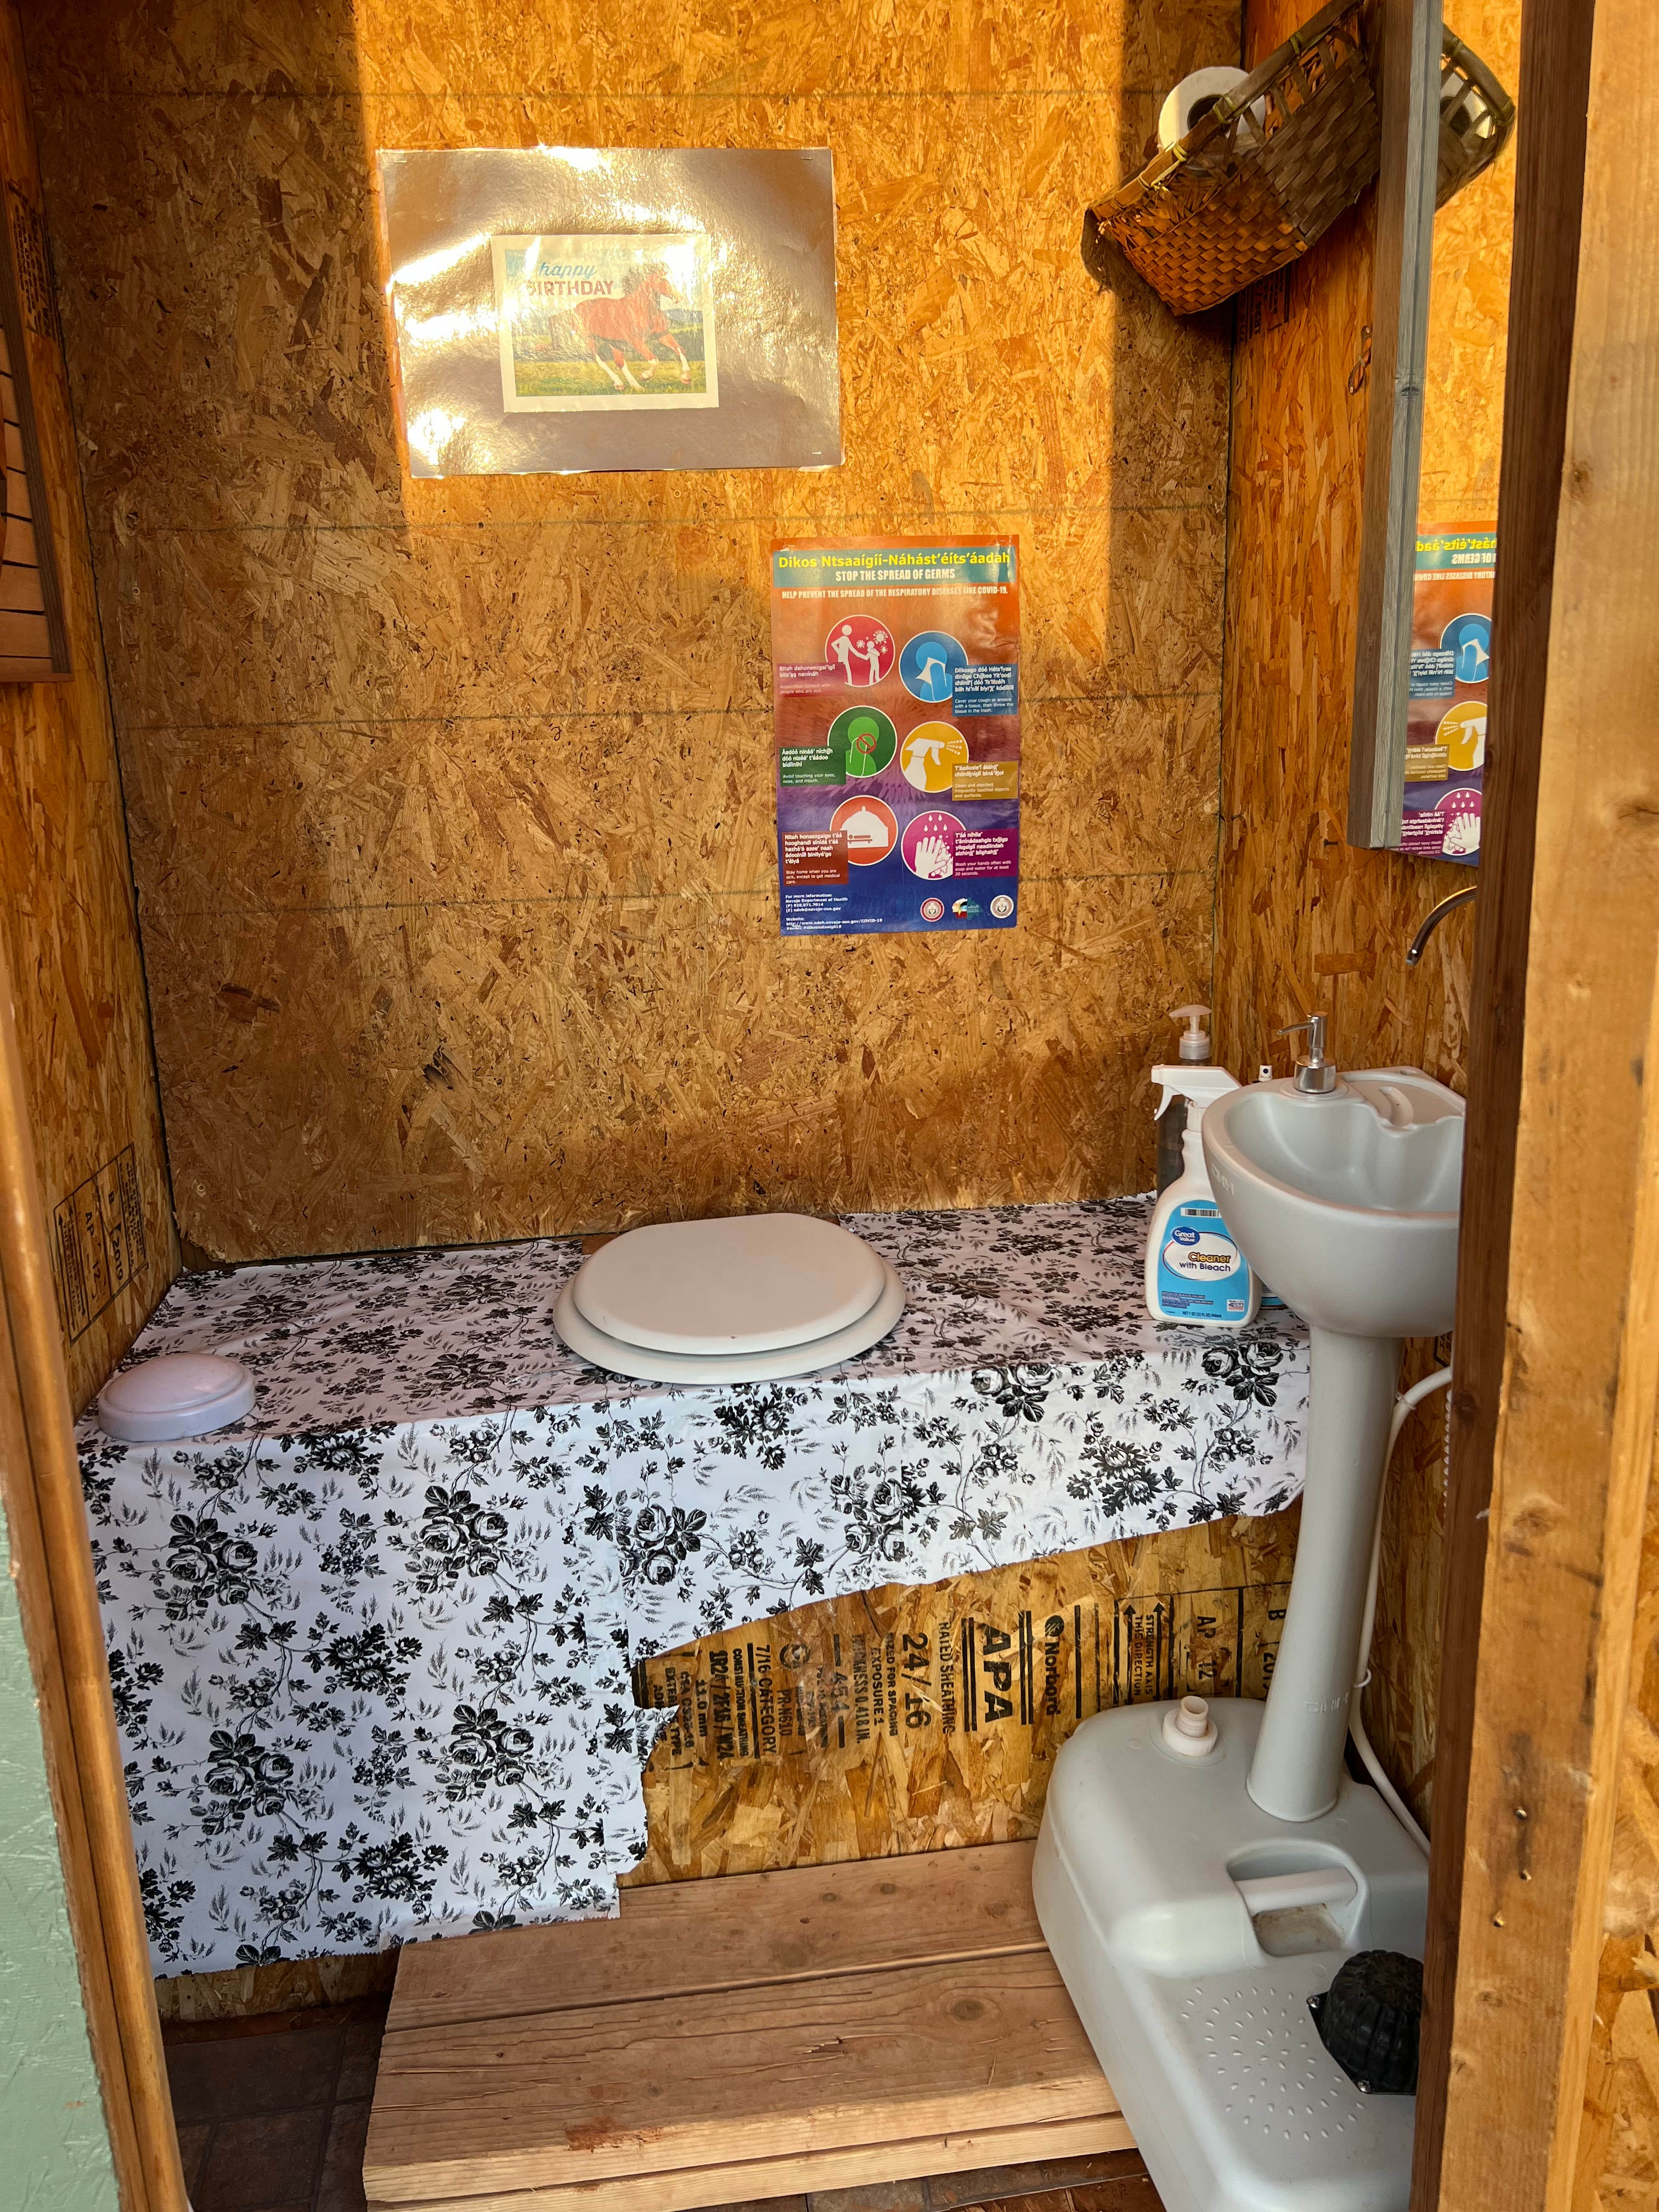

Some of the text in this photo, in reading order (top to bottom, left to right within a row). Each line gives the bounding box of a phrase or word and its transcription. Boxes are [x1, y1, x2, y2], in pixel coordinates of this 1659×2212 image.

[539, 262, 596, 280] happy
[778, 556, 817, 568] Dikos
[836, 568, 955, 582] STOP THE SPREAD OF GERMS
[888, 588, 930, 596] RESPIRATORY
[932, 588, 961, 596] DISEASES
[85, 1211, 101, 1280] AP 12
[1175, 1230, 1195, 1238] Great
[112, 1238, 123, 1280] 2019
[1188, 1252, 1231, 1263] Cleaner
[1200, 1263, 1231, 1272] Bleach
[1268, 1609, 1287, 1621] B
[1133, 1615, 1143, 1696] THIS DIRECTION
[1146, 1614, 1154, 1668] STRENGTH
[1197, 1616, 1218, 1680] AP 12
[831, 1671, 850, 1712] 454
[871, 1647, 884, 1726] EXPOSURE 1
[887, 1667, 896, 1688] FOR
[939, 1621, 956, 1734] RATED SHEATHING
[983, 1622, 1013, 1724] APA
[1044, 1641, 1064, 1716] Norbord
[695, 1679, 708, 1737] 11.0 mm
[713, 1692, 731, 1722] 2F16
[733, 1648, 749, 1756] CONSTRUCTION SHEATHING
[755, 1645, 777, 1753] 7/16 CATEGORY
[777, 1689, 792, 1736] PR-N610
[855, 1696, 870, 1726] 0.418
[888, 1690, 898, 1736] SPACING
[670, 1726, 682, 1756] TYPE
[715, 1733, 735, 1760] W24
[856, 1728, 870, 1744] IN.
